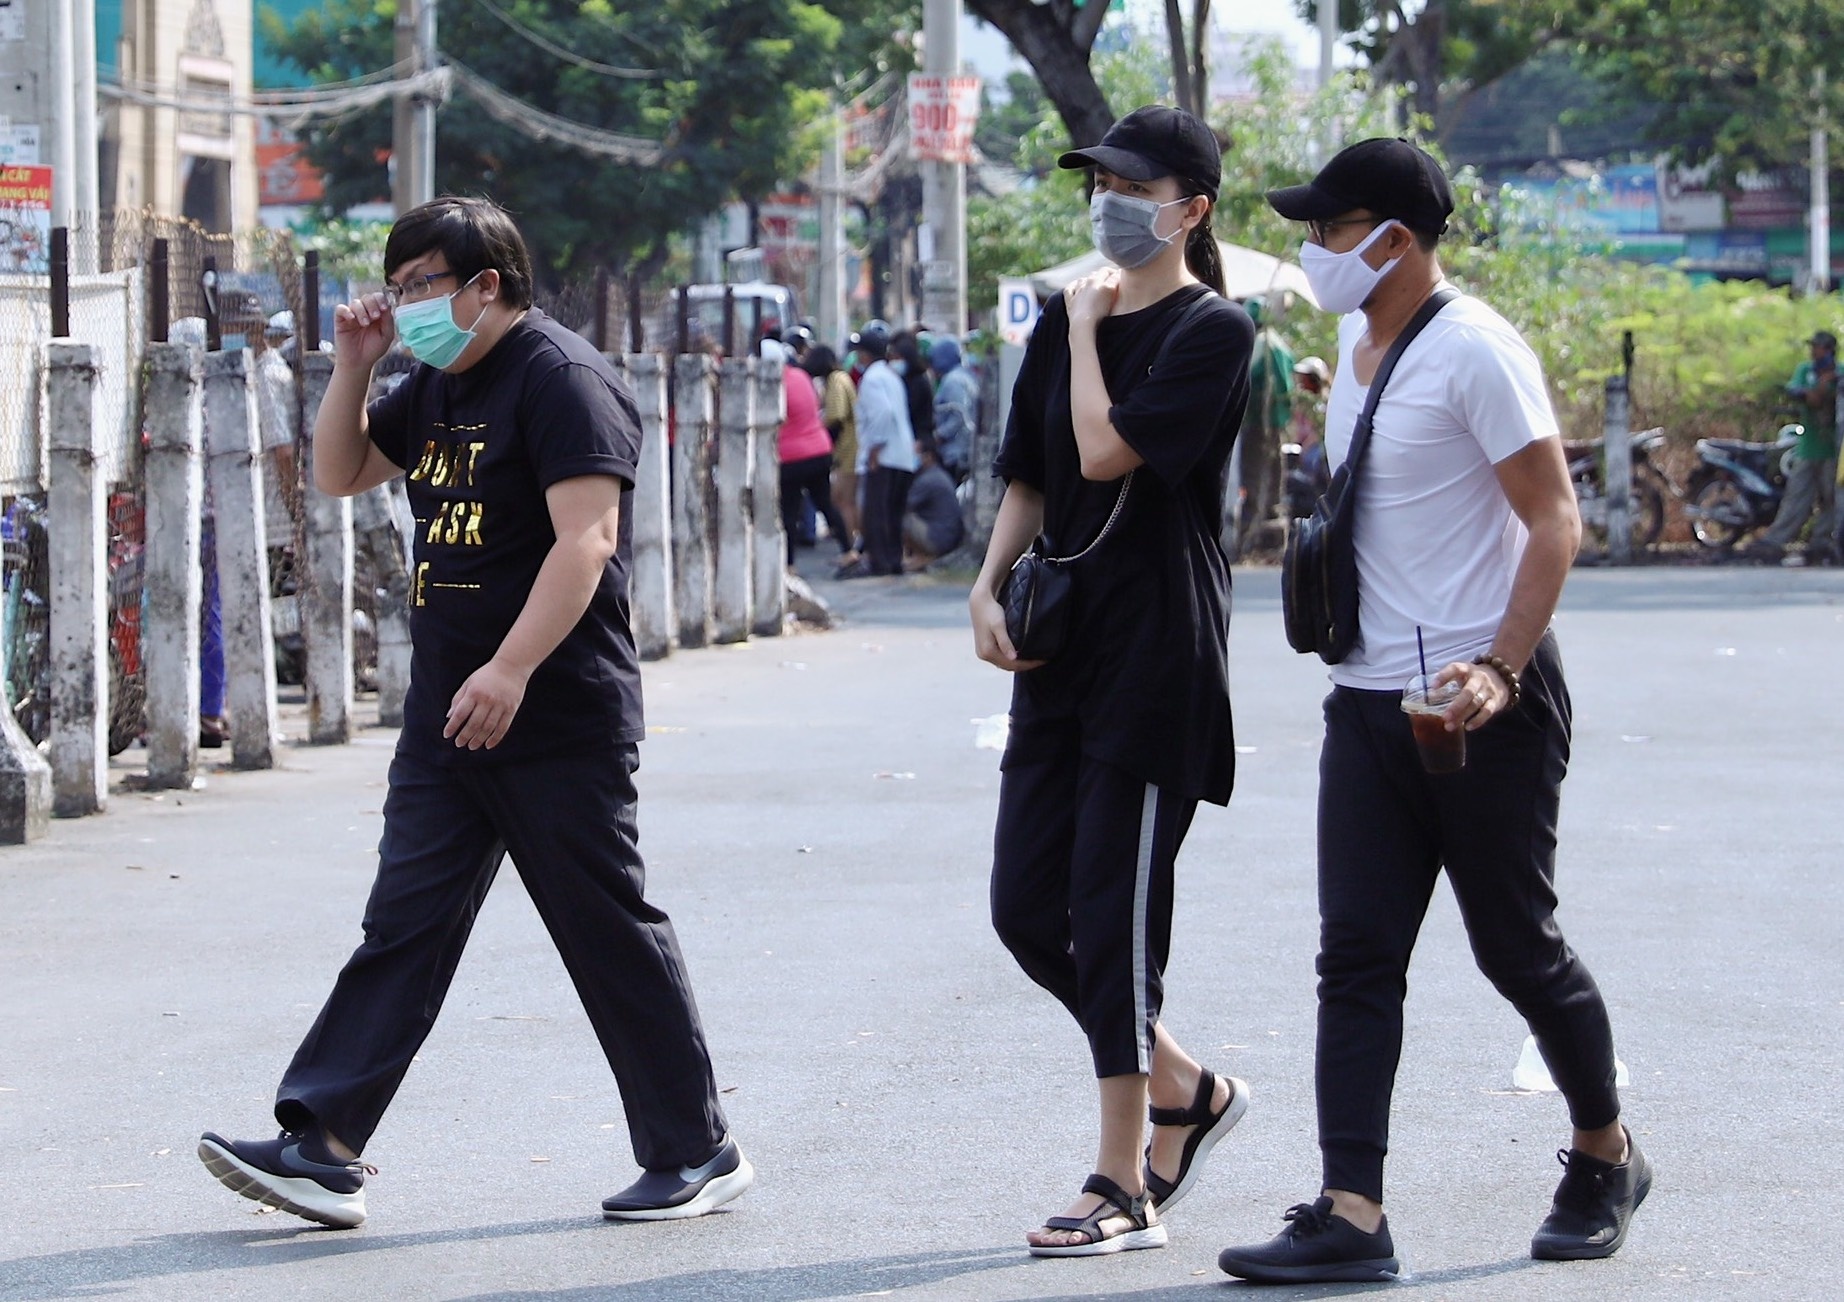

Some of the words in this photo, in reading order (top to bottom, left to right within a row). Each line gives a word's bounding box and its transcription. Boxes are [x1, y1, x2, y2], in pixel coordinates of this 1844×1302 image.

[912, 102, 957, 132] 900
[1009, 292, 1030, 324] D
[426, 501, 484, 545] ASK
